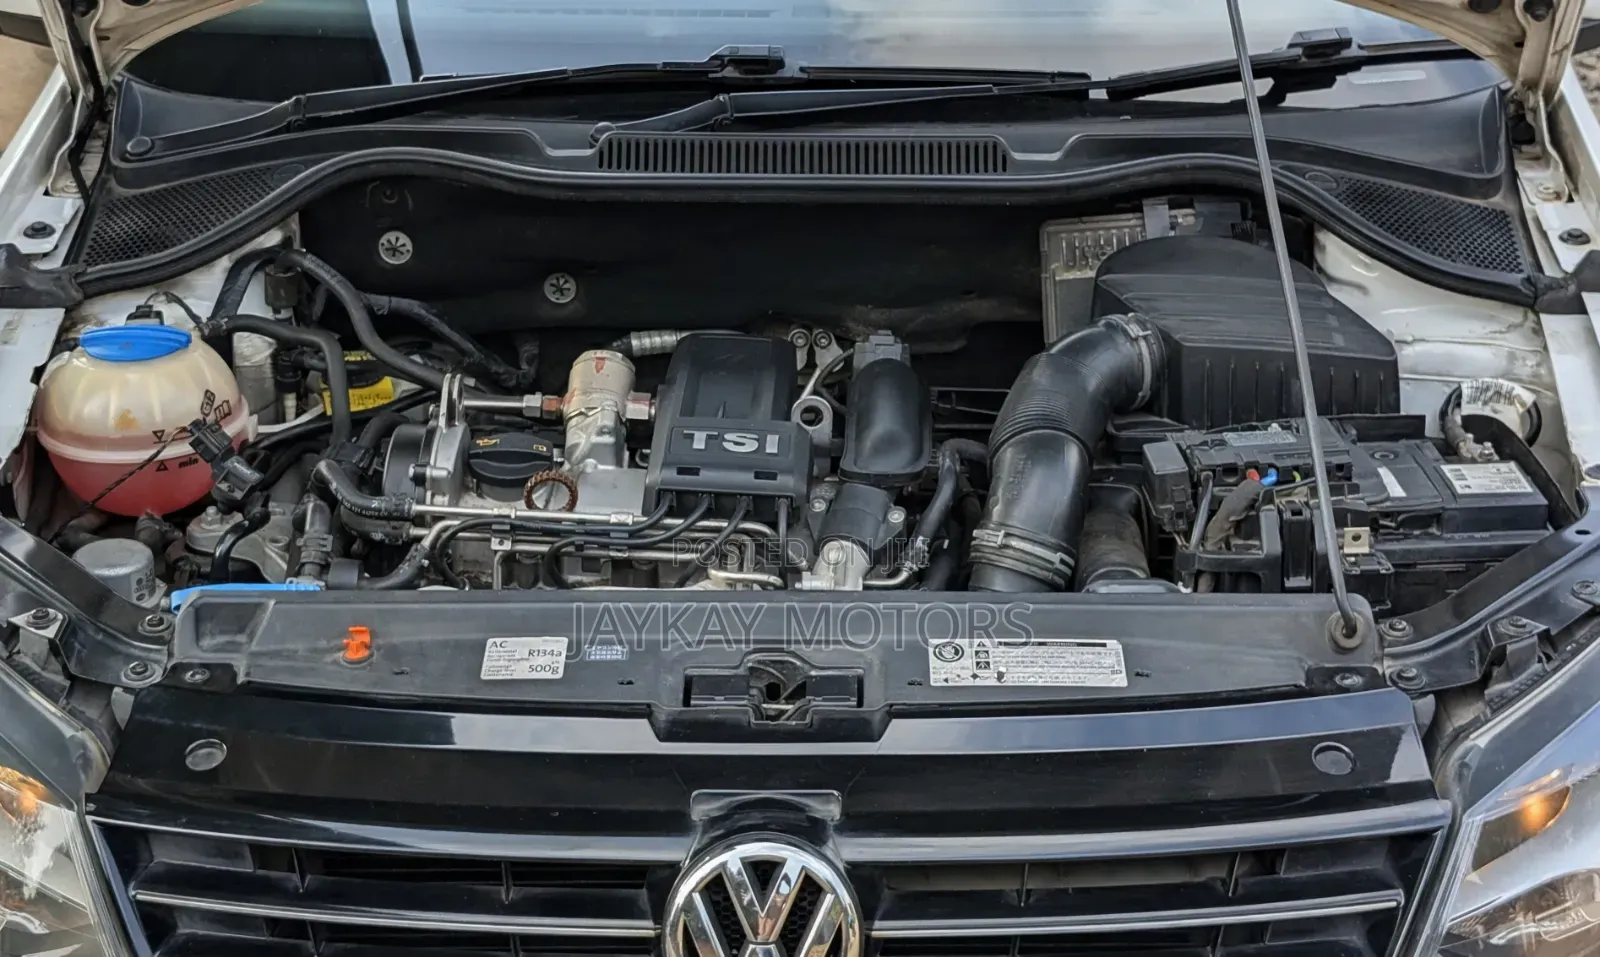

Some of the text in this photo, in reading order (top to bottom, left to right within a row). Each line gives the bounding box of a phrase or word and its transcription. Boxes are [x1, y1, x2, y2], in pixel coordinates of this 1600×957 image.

[683, 430, 779, 454] TSI
[489, 640, 508, 649] AC
[528, 648, 562, 658] R134a
[528, 664, 560, 675] 500g
